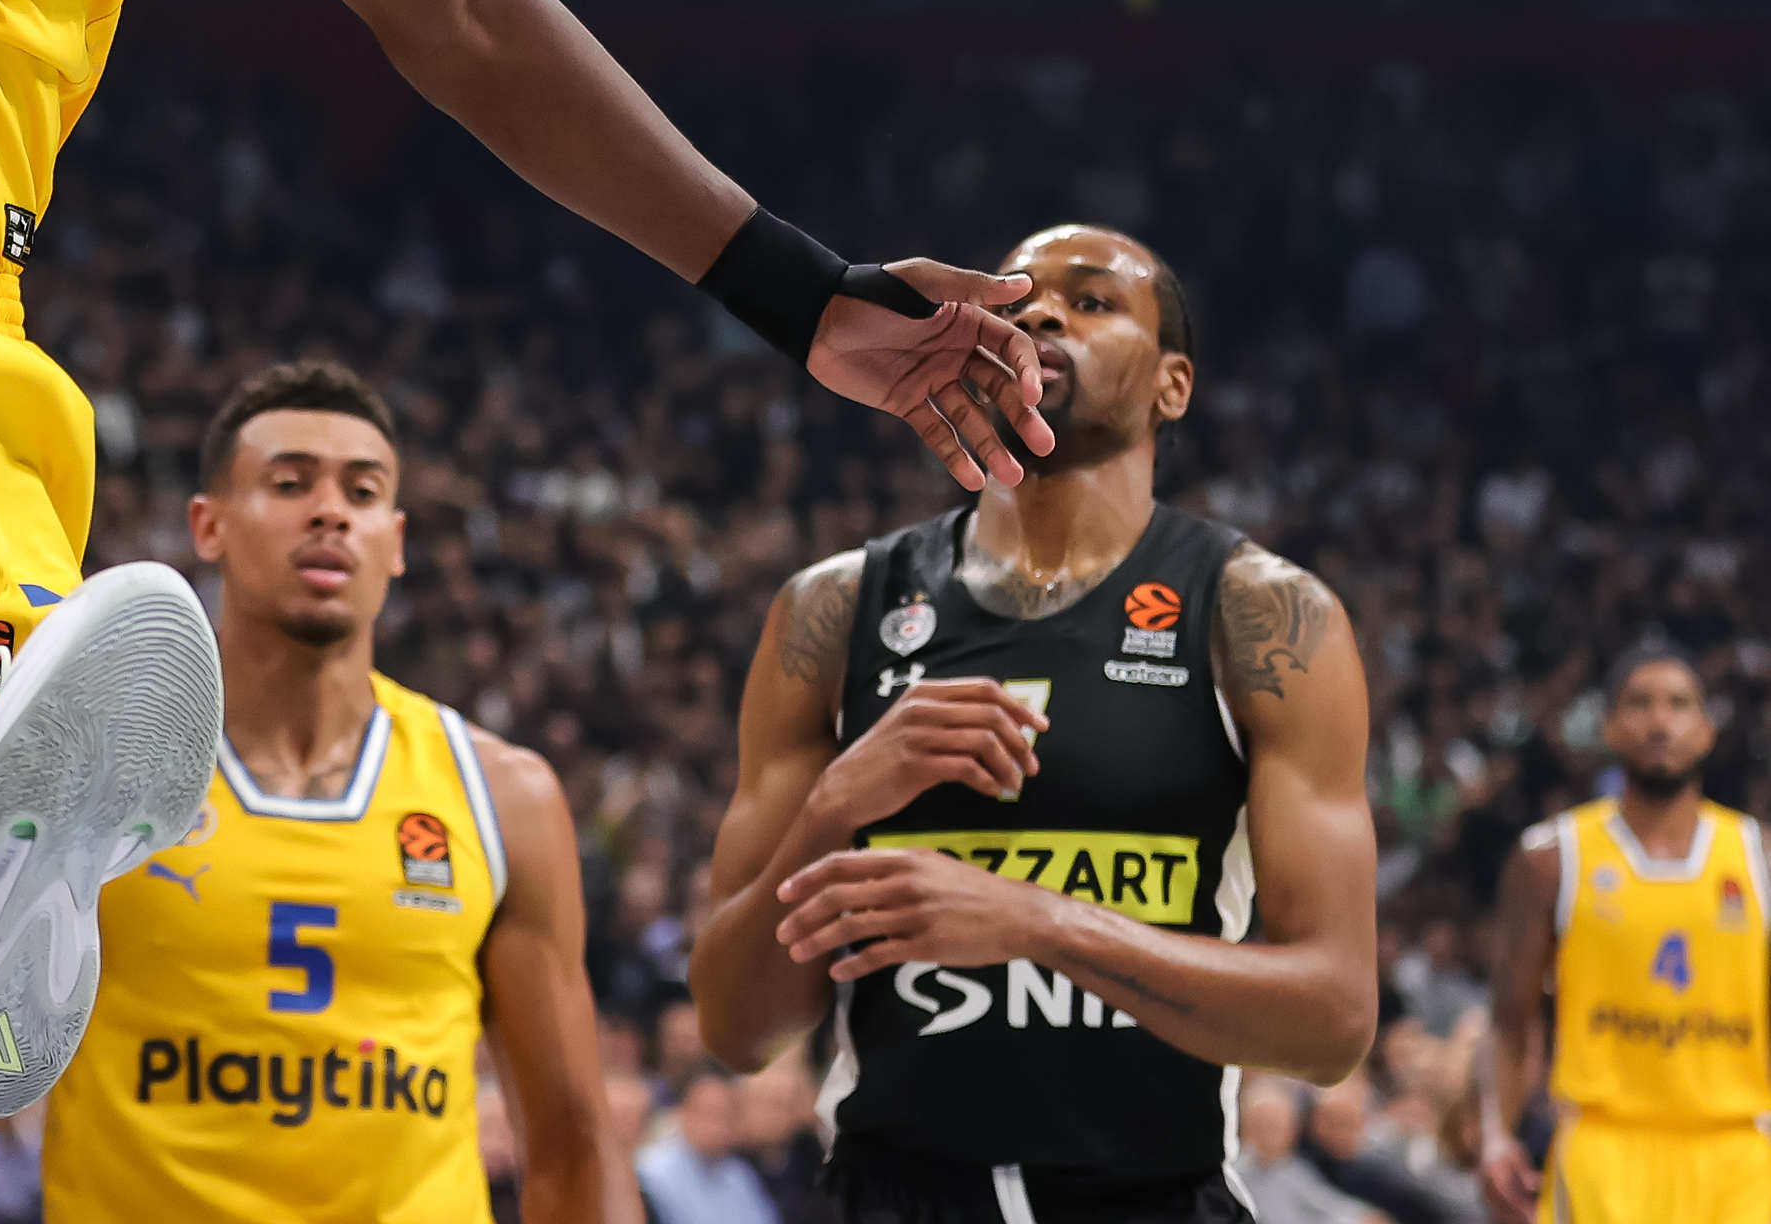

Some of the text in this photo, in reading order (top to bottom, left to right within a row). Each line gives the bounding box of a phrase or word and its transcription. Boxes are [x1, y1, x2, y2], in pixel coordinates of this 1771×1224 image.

[268, 901, 338, 1014] 5
[1650, 931, 1693, 994] 4
[137, 1038, 448, 1127] Playtika
